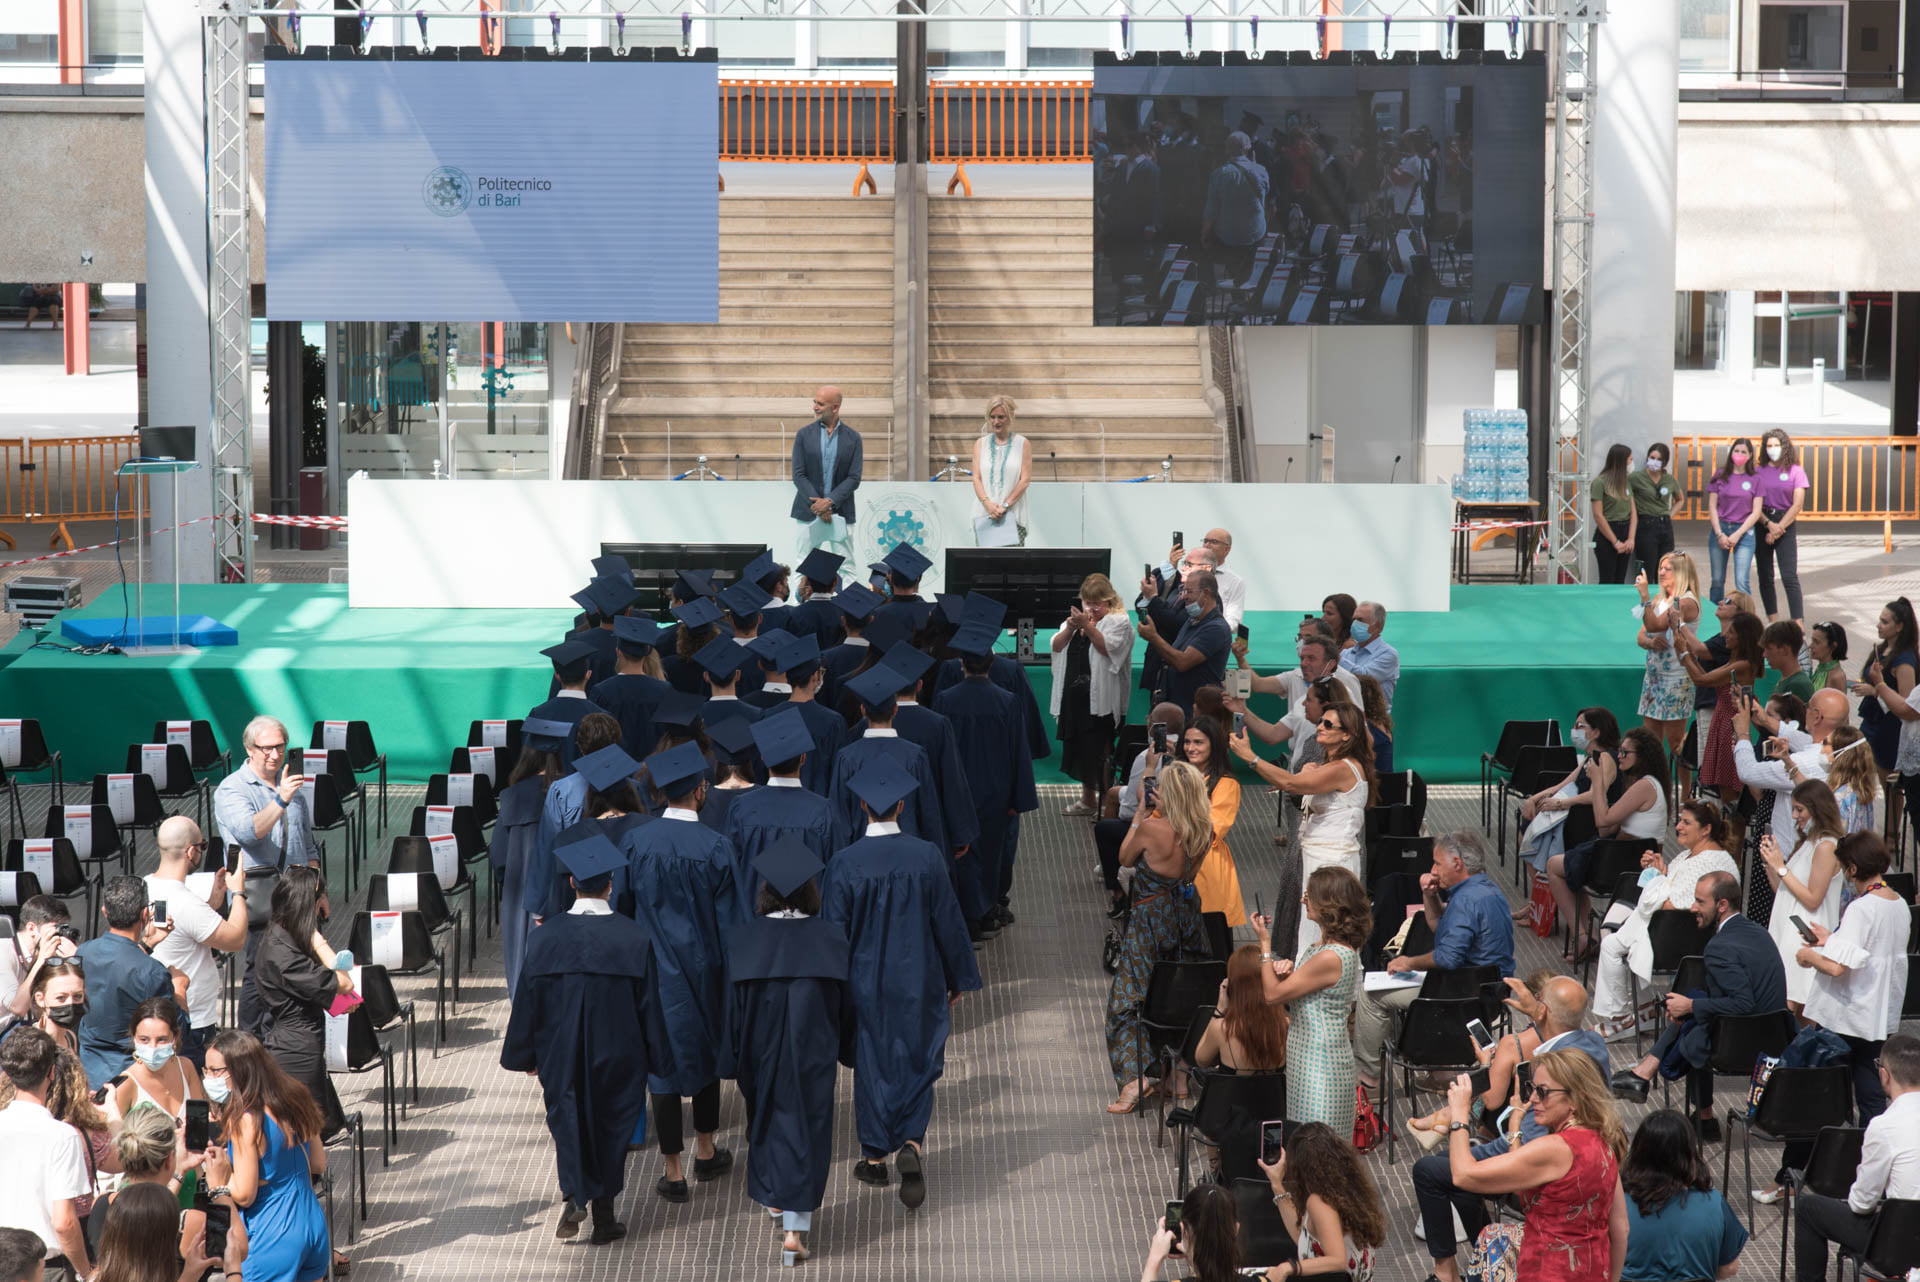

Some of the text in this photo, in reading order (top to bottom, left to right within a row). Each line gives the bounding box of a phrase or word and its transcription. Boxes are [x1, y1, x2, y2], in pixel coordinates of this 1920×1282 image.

[478, 177, 552, 191] Politecnico
[478, 193, 521, 207] di Bari
